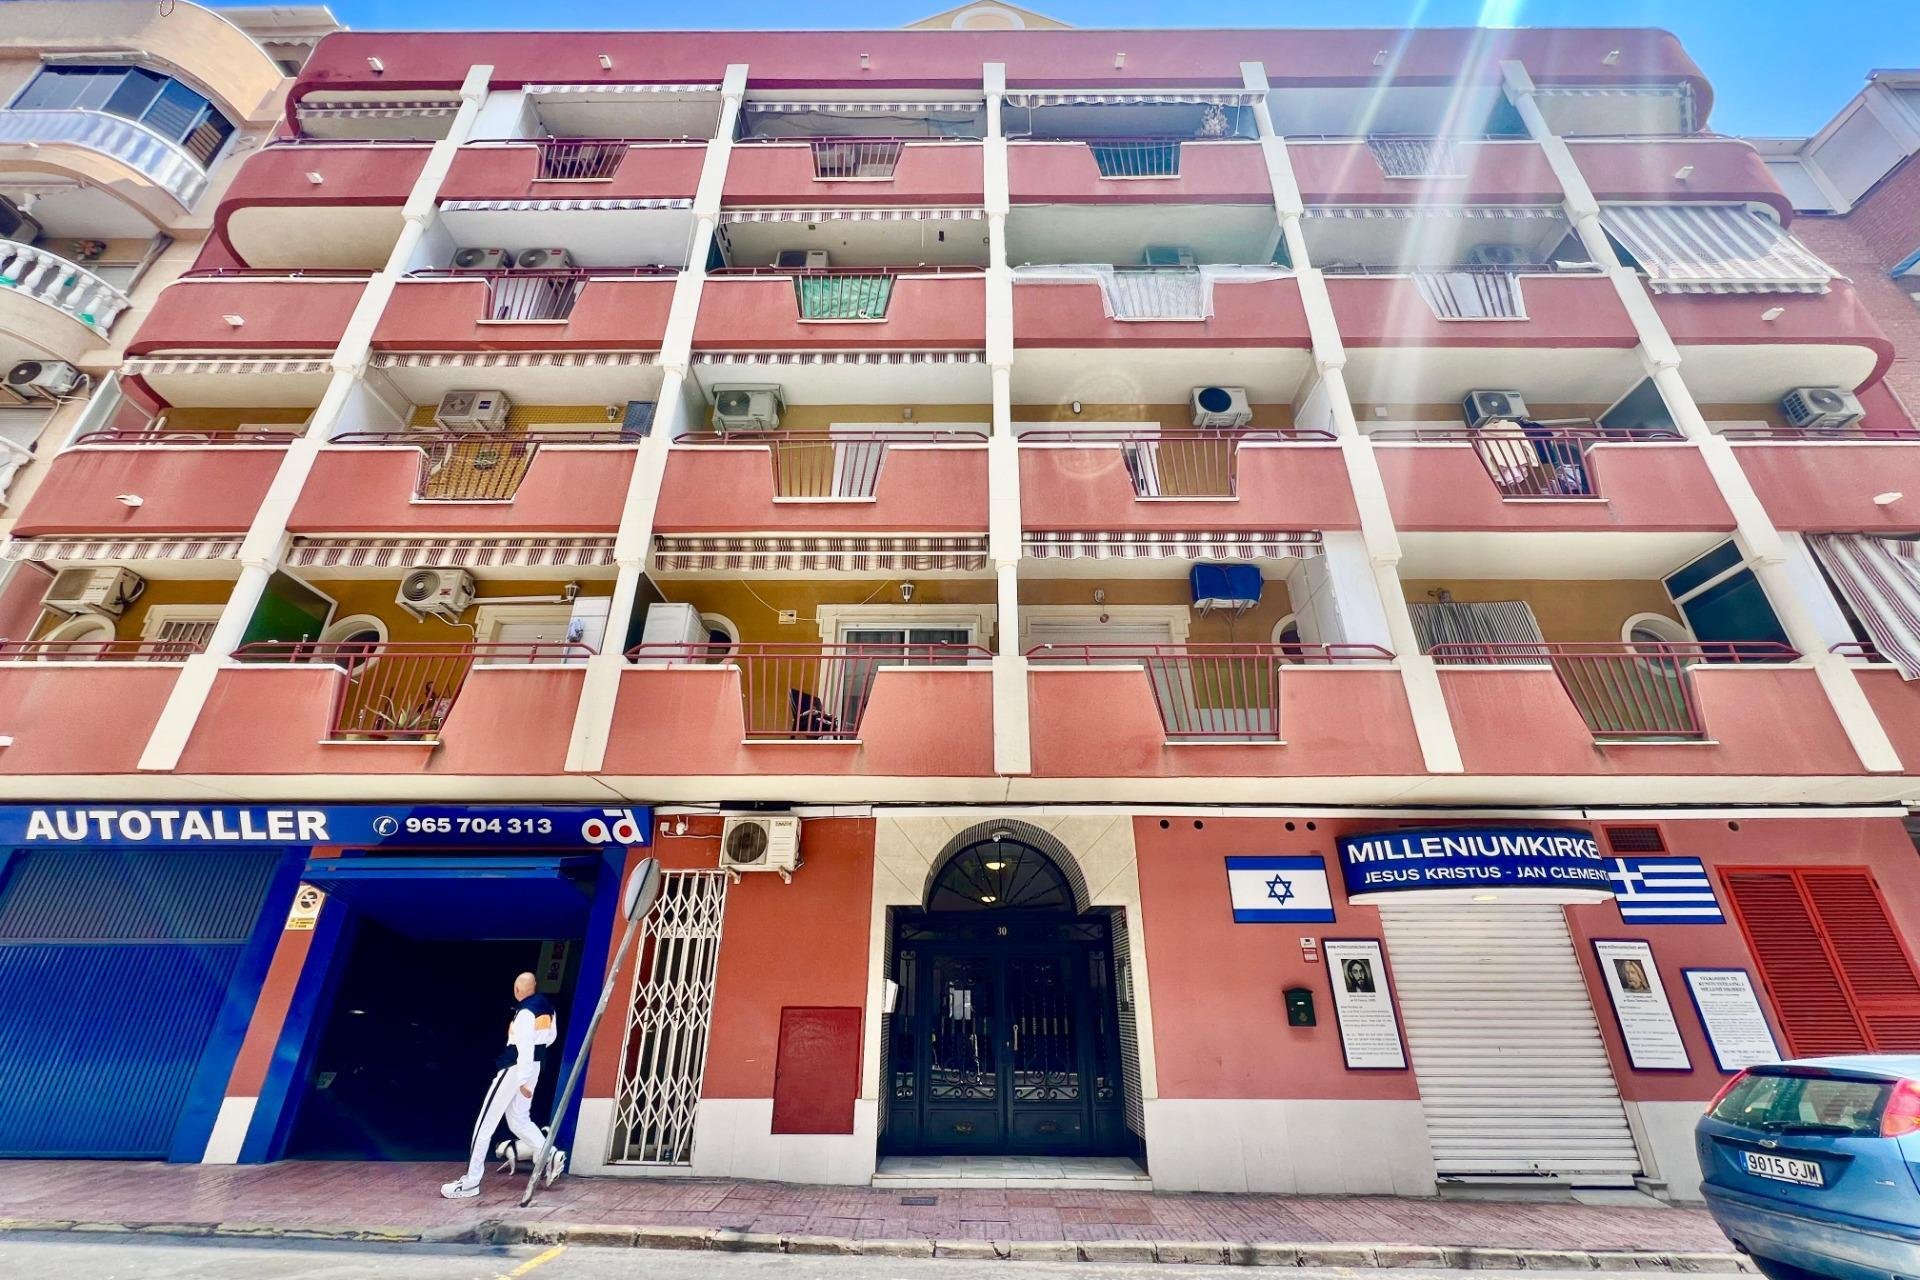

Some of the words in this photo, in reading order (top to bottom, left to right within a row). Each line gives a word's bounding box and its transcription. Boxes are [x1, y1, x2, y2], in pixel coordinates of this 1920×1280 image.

[26, 810, 330, 841] AUTOTALLER
[406, 817, 450, 833] 965
[457, 818, 501, 833] 704
[507, 818, 552, 834] 313
[1347, 836, 1602, 864] MILLENIUMKIRKE
[1364, 868, 1420, 883] JESUS
[1425, 866, 1501, 880] KRISTUS
[1517, 866, 1546, 879] JAN
[996, 926, 1007, 936] 30
[1748, 1154, 1785, 1175] 9015
[1788, 1161, 1819, 1182] CJM
